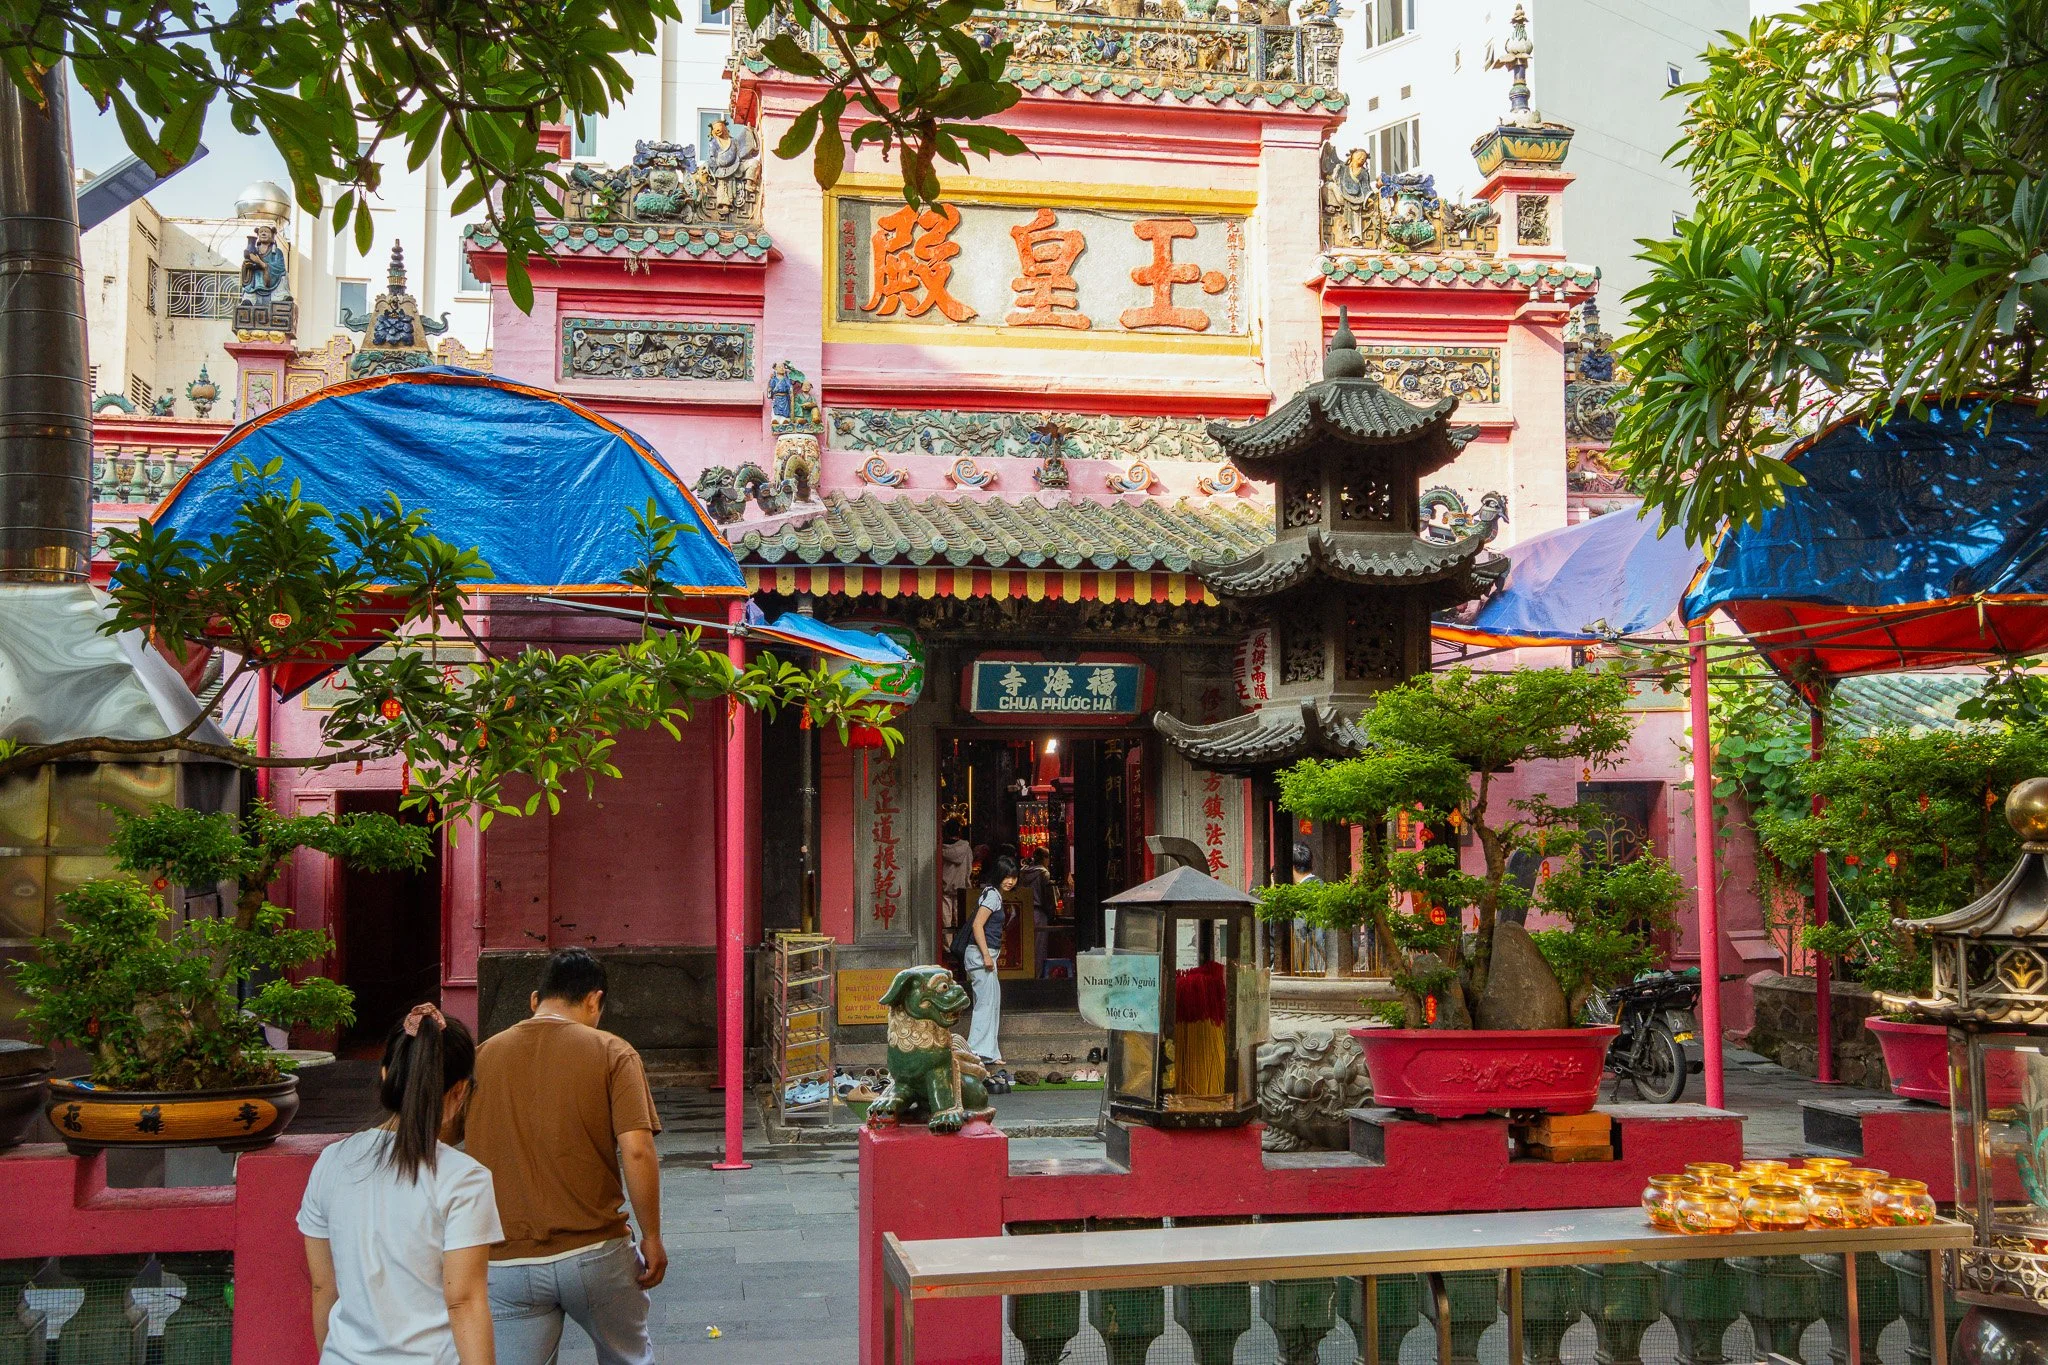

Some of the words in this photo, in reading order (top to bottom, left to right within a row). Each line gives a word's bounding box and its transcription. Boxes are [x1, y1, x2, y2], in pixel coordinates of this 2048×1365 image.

[999, 665, 1117, 698] 福海寺
[1083, 976, 1113, 988] Nhang
[1131, 976, 1156, 989] Người
[1106, 1007, 1121, 1019] Một
[1122, 1008, 1138, 1021] Cây
